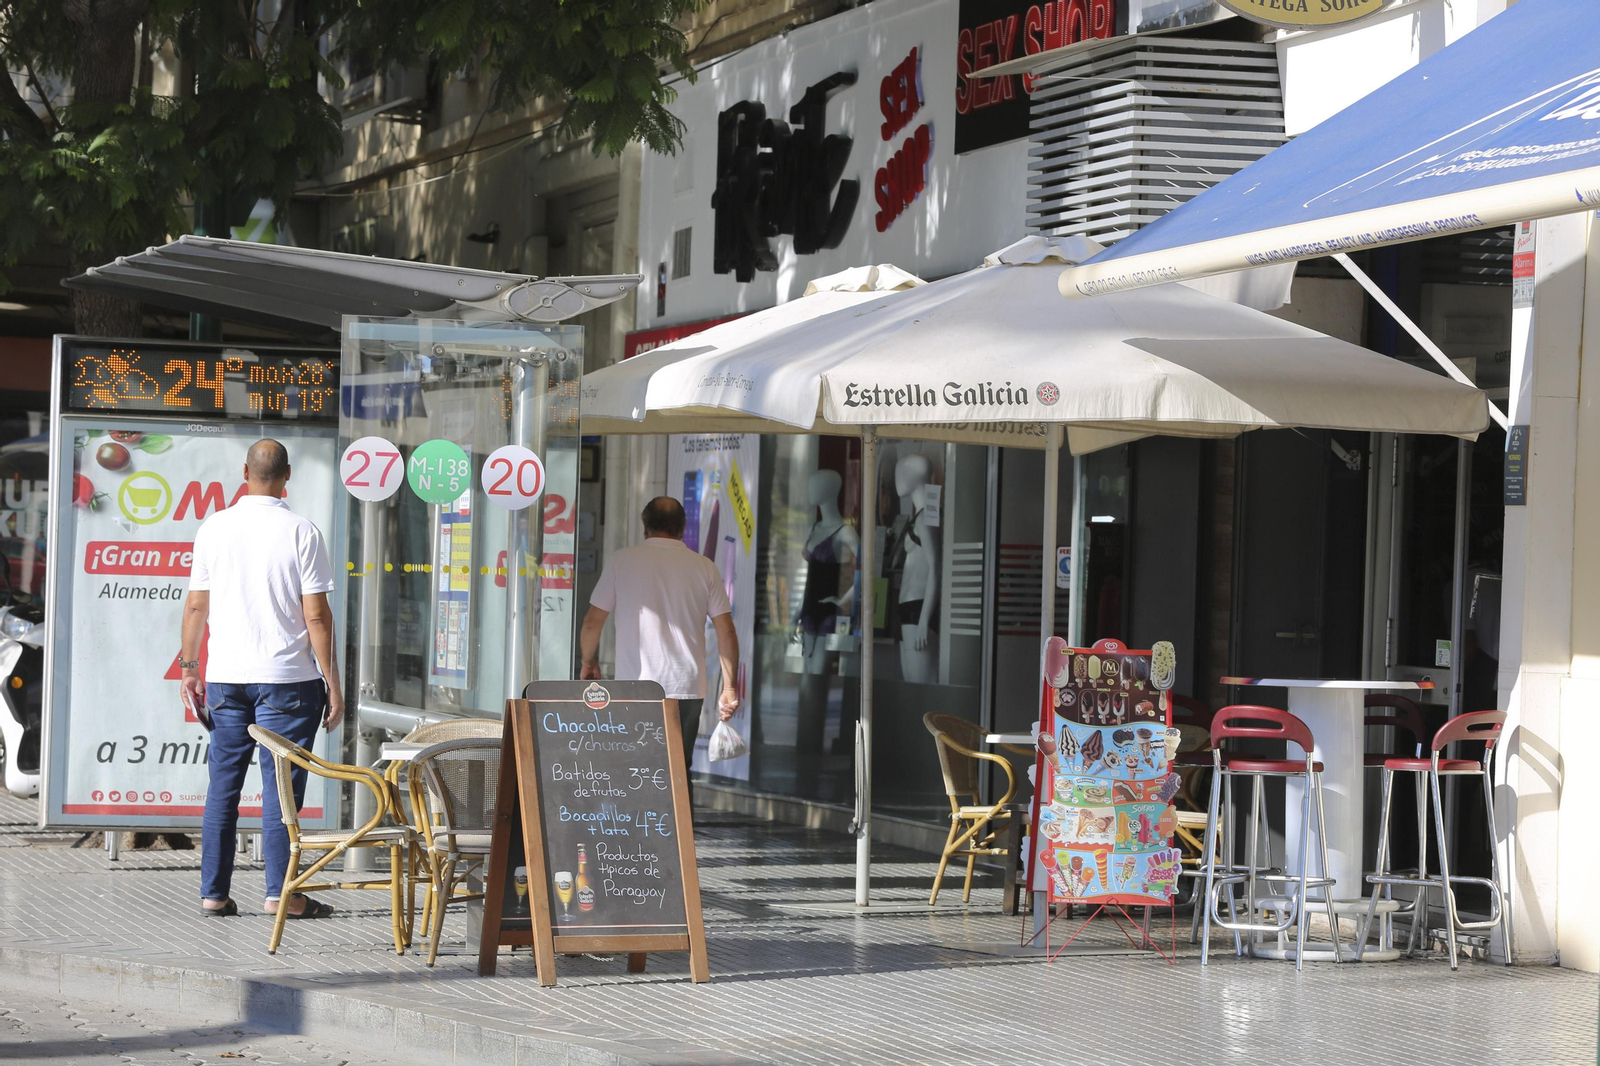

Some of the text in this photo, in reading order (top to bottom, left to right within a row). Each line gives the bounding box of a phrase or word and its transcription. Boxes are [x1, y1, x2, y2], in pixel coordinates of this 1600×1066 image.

[954, 13, 1019, 115] SEX
[879, 46, 924, 141] SEX
[875, 122, 934, 233] SHOP
[1244, 252, 1266, 266] WIGS
[1265, 249, 1284, 261] AND
[1326, 235, 1359, 252] BEAUTY
[1357, 231, 1378, 247] AND
[1374, 221, 1436, 243] HAIRDRESSING
[1514, 258, 1533, 269] Alarma
[248, 388, 289, 411] min
[842, 381, 938, 408] Estrella
[942, 381, 1030, 408] Galicia
[185, 424, 228, 433] JCDecaux
[344, 449, 401, 488] 27
[410, 456, 469, 477] M-138
[487, 458, 541, 498] 20
[731, 472, 752, 539] NOVEDAD
[91, 545, 162, 570] ¡Gran
[98, 582, 183, 601] Alameda
[542, 711, 629, 734] Chocolate
[96, 740, 117, 764] a
[127, 735, 148, 764] 3
[552, 761, 611, 781] Batidos
[574, 780, 627, 798] de frutas
[559, 804, 632, 823] Bocadillos
[600, 821, 630, 836] lata
[595, 841, 659, 863] Productos
[644, 862, 661, 879] de
[603, 878, 666, 909] Paraguay
